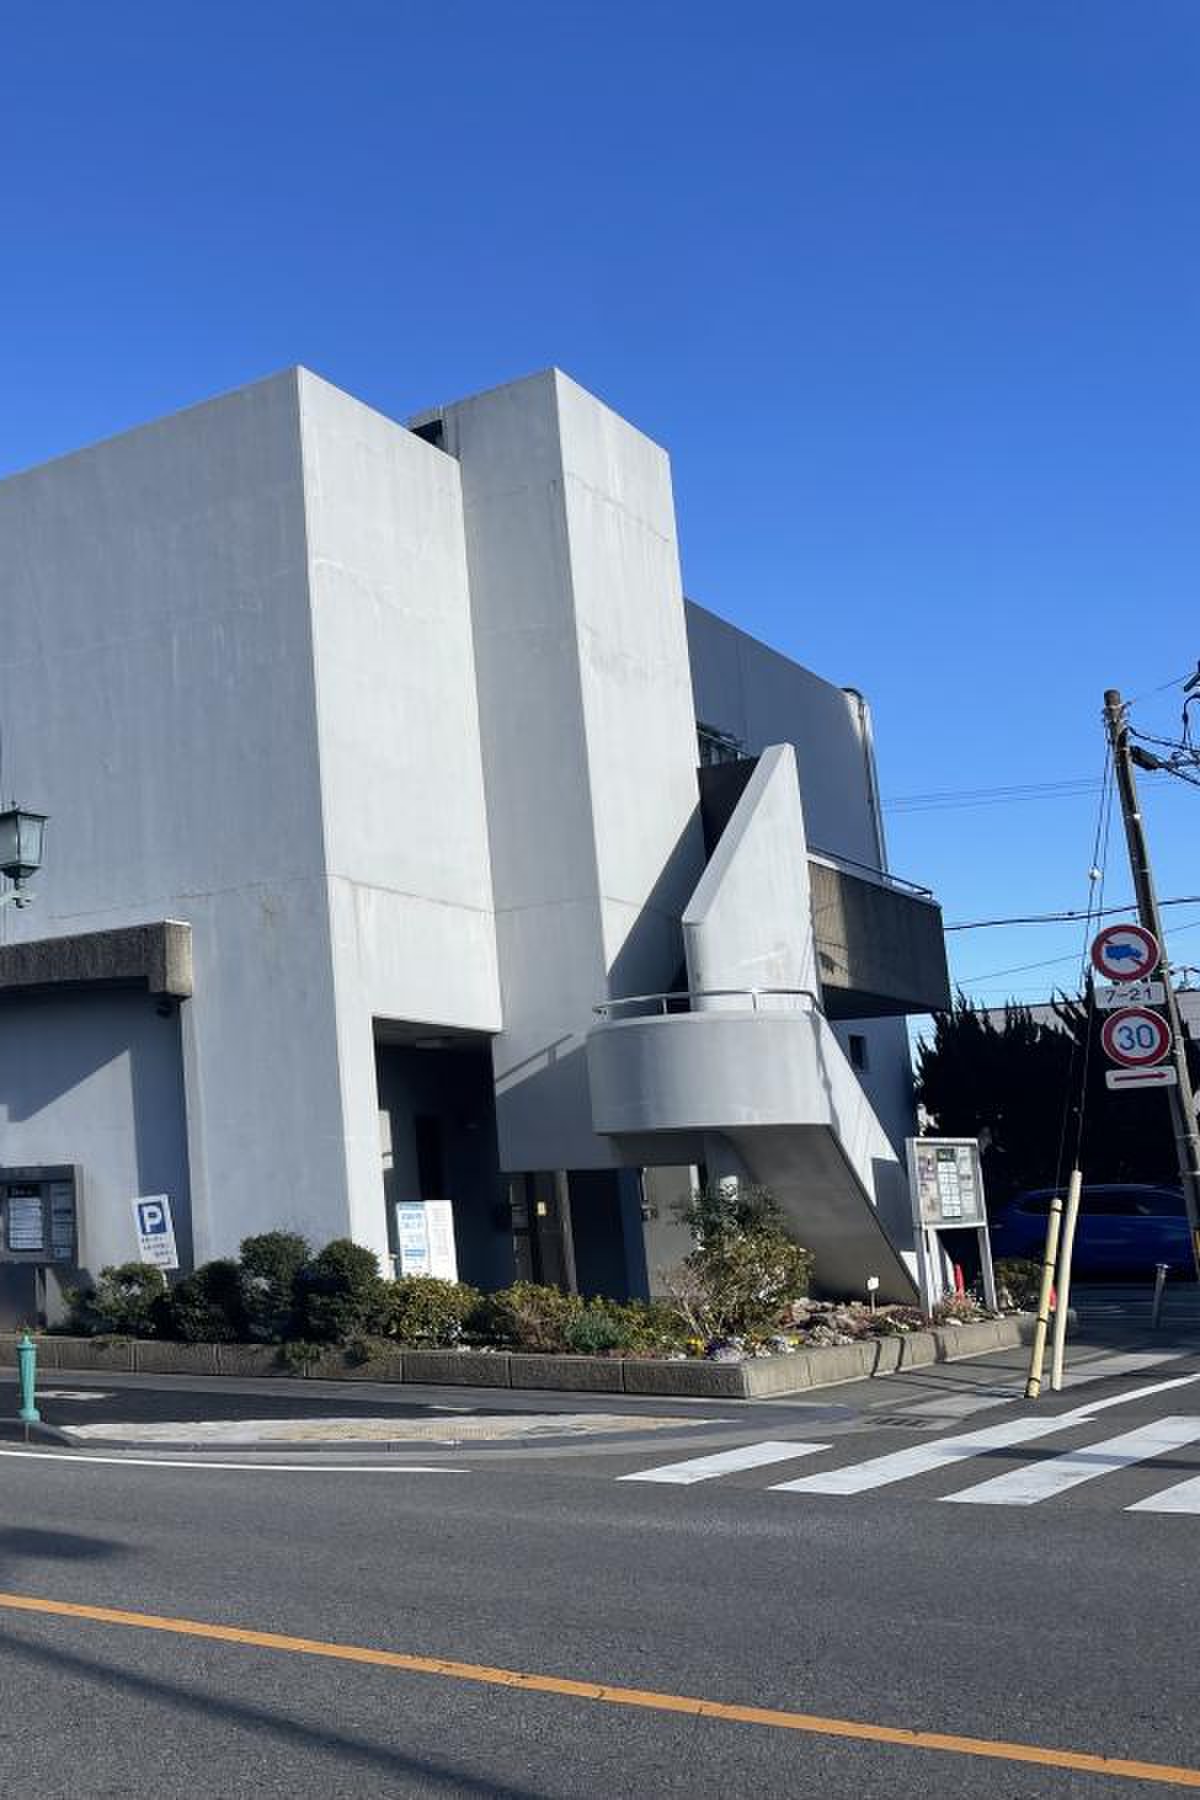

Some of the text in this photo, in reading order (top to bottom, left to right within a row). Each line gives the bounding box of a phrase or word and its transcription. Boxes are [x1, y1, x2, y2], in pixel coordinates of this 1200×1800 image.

[1105, 986, 1153, 1003] 7-21
[1118, 1023, 1155, 1051] 30
[142, 1205, 162, 1233] P
